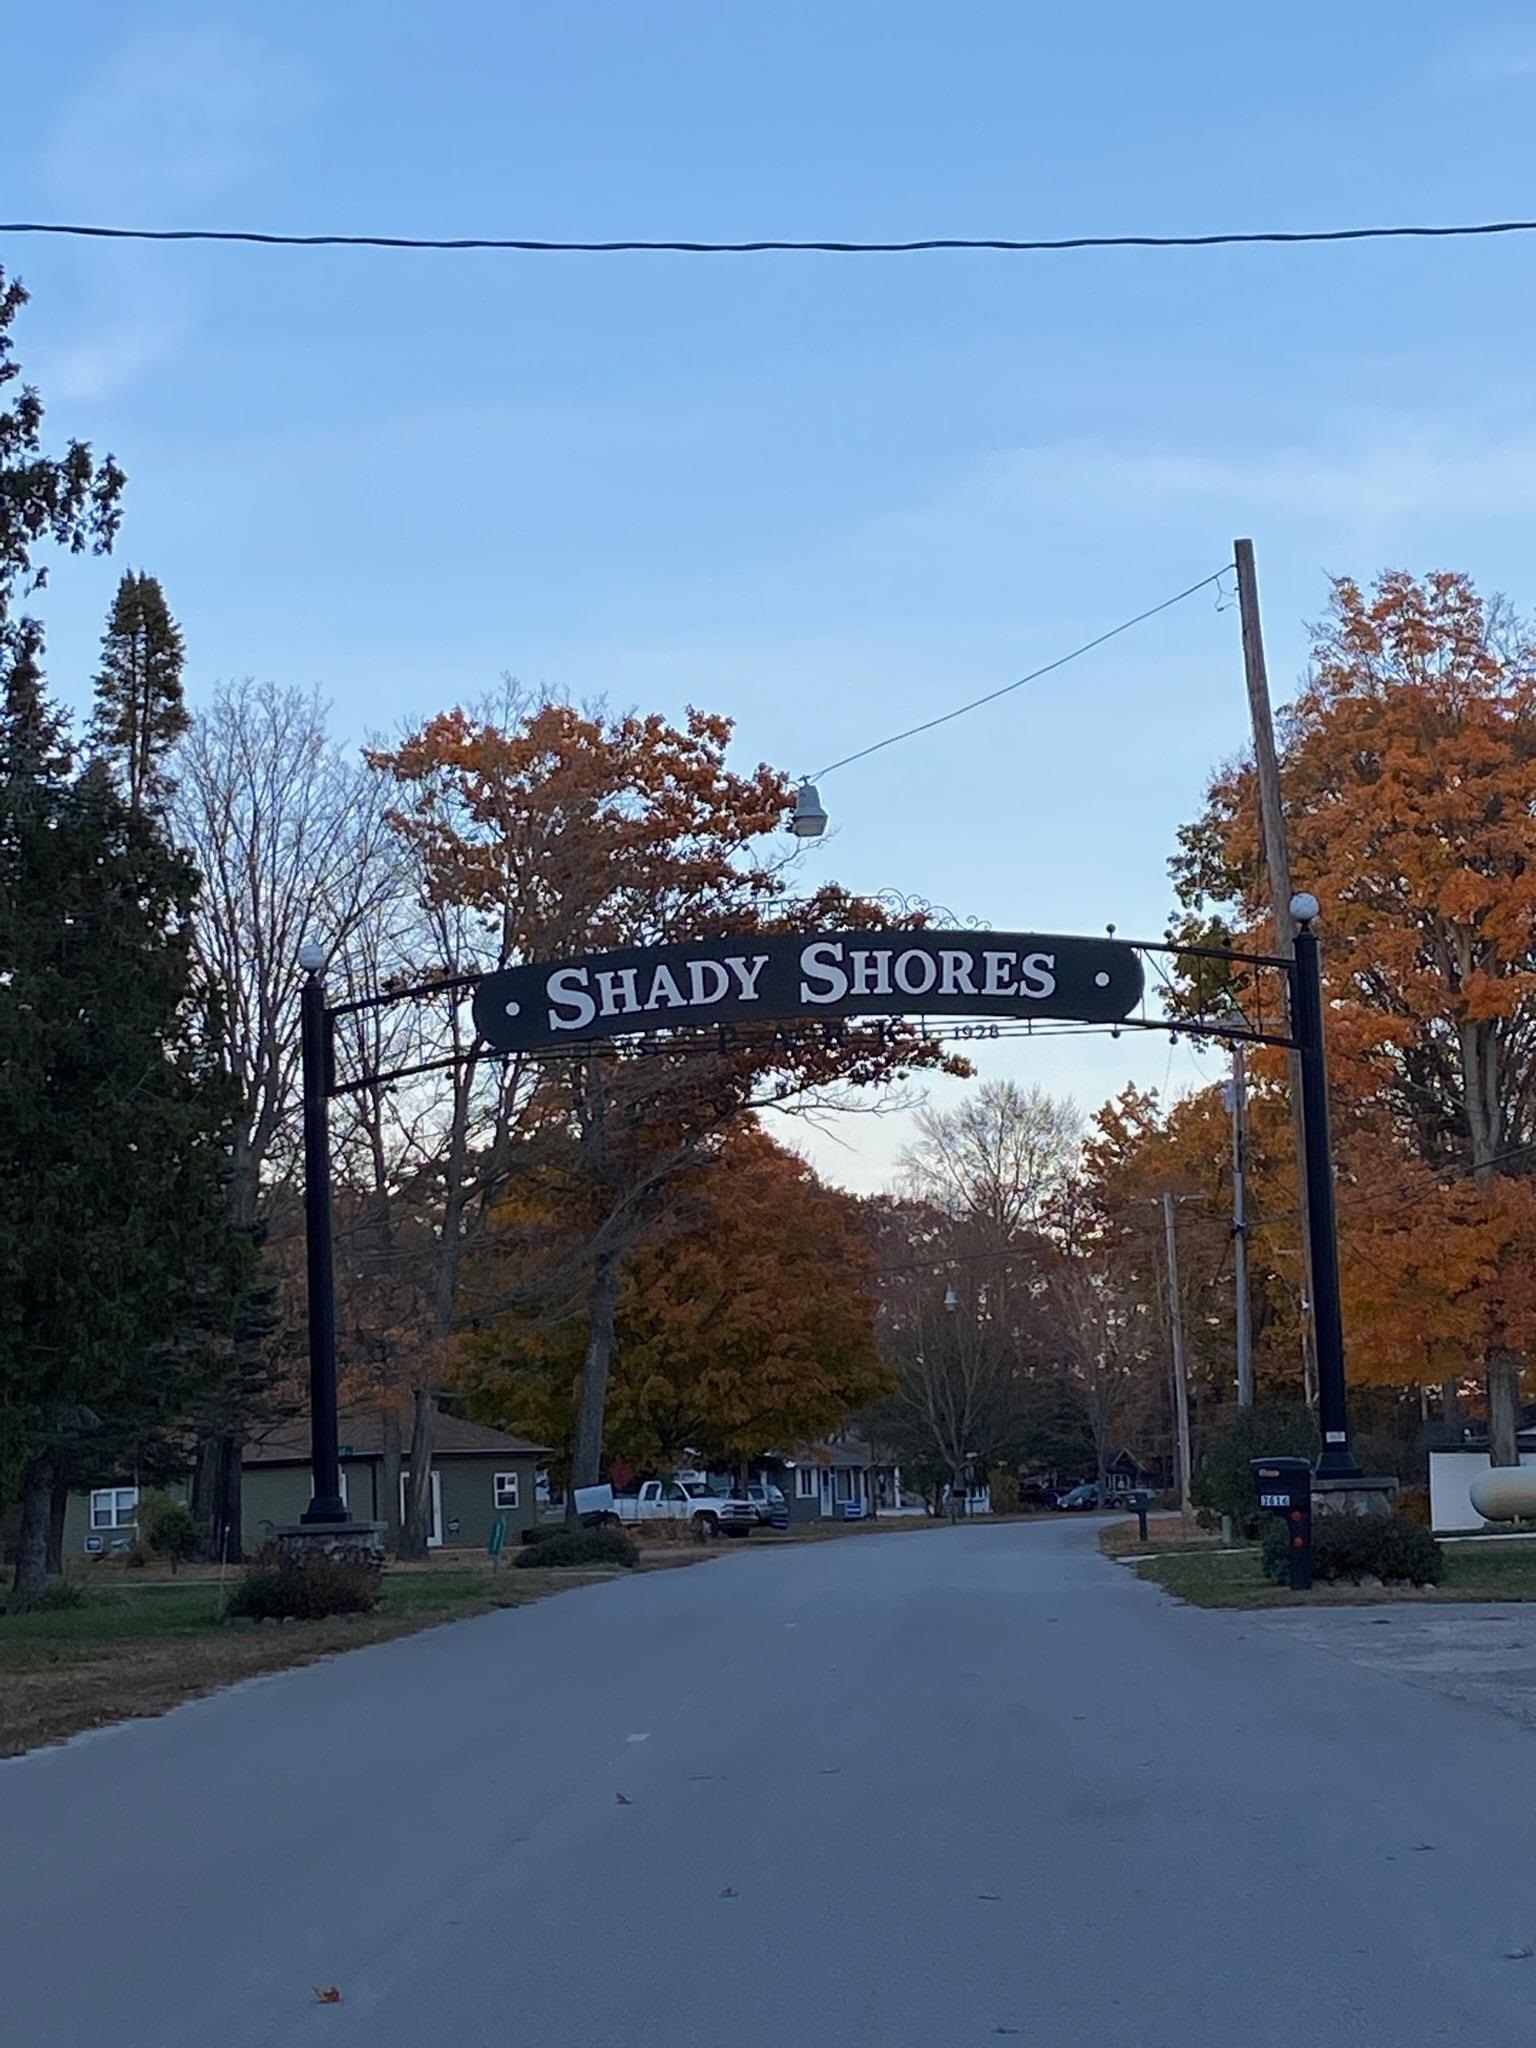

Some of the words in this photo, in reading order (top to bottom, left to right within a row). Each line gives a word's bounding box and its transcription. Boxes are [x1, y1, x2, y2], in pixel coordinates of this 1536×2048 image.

[546, 955, 769, 1031] SHADY
[800, 942, 1056, 1004] SHORES
[953, 1024, 1000, 1040] 1928
